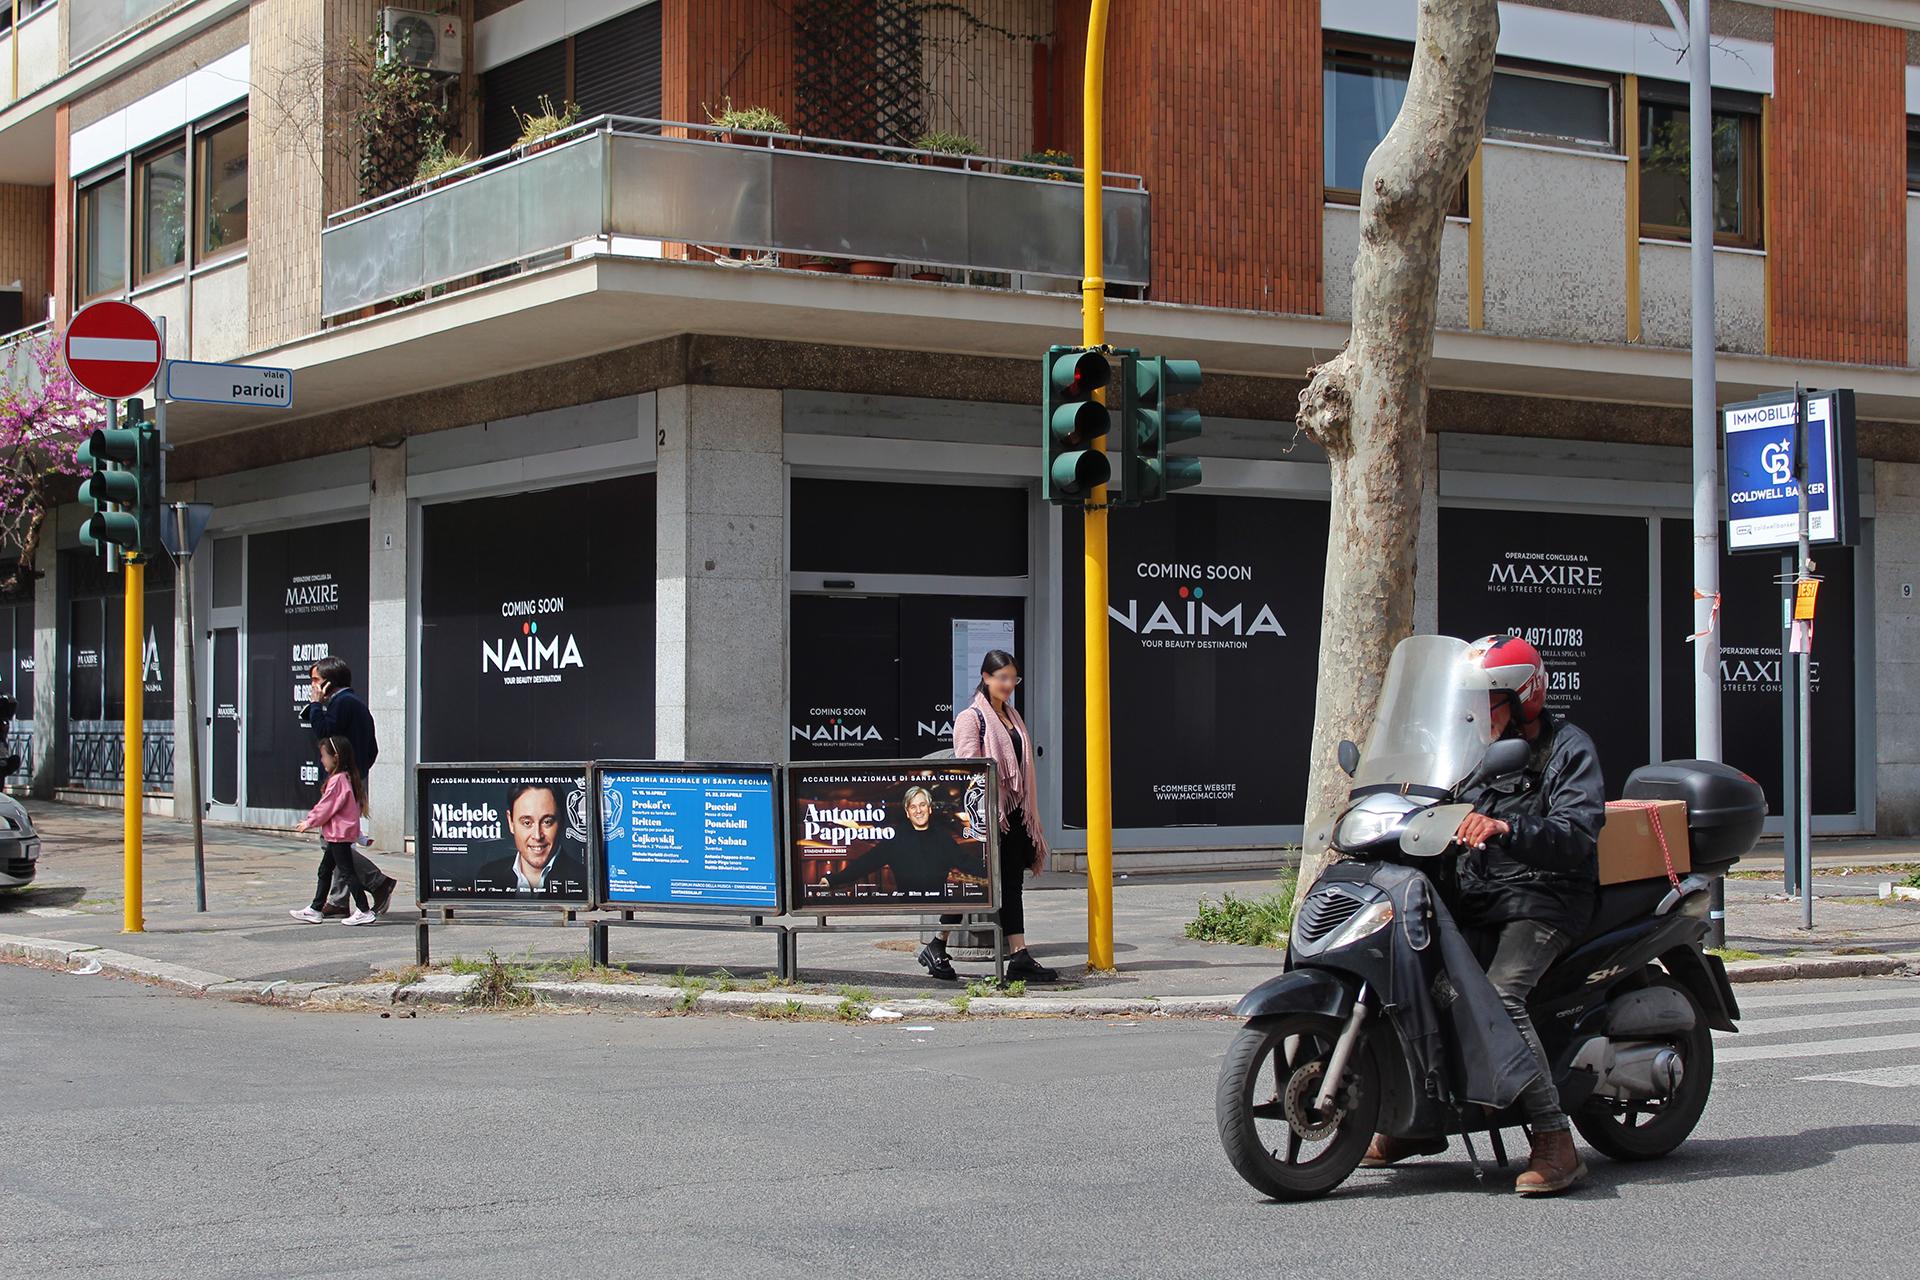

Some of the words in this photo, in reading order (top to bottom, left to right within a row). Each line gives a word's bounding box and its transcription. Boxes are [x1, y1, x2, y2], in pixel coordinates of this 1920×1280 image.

[264, 370, 284, 379] viale
[232, 384, 284, 398] parioli
[1733, 402, 1816, 425] IMMOBILIAE
[658, 429, 666, 446] 2
[1732, 488, 1784, 504] COLDWELL
[1786, 483, 1824, 498] BAKER
[1505, 552, 1544, 560] OPERAZIONE
[1137, 563, 1202, 579] COMING
[1206, 565, 1252, 580] SOON
[1488, 564, 1602, 586] MAXIRE
[285, 584, 338, 606] MAXIRE
[1546, 587, 1602, 595] CONSULTANCY
[1904, 585, 1910, 596] 9
[502, 600, 535, 616] COMING
[538, 597, 564, 614] SOON
[1141, 640, 1163, 648] YOUR
[1165, 640, 1195, 649] BEAUTY
[1197, 640, 1248, 649] DESTINATION
[516, 676, 532, 684] BEAUTY
[1153, 784, 1202, 792] E-COMMERCE
[1156, 792, 1234, 800] WWW.MACIMACI.COM
[432, 802, 497, 822] Michele
[705, 802, 737, 811] Puccini
[803, 803, 885, 822] Antonio
[632, 817, 661, 826] Britten
[705, 819, 747, 828] Ponchielli
[432, 821, 502, 839] Mariotti
[804, 821, 895, 846] Pappano
[705, 836, 716, 844] De
[718, 836, 747, 846] Sabata
